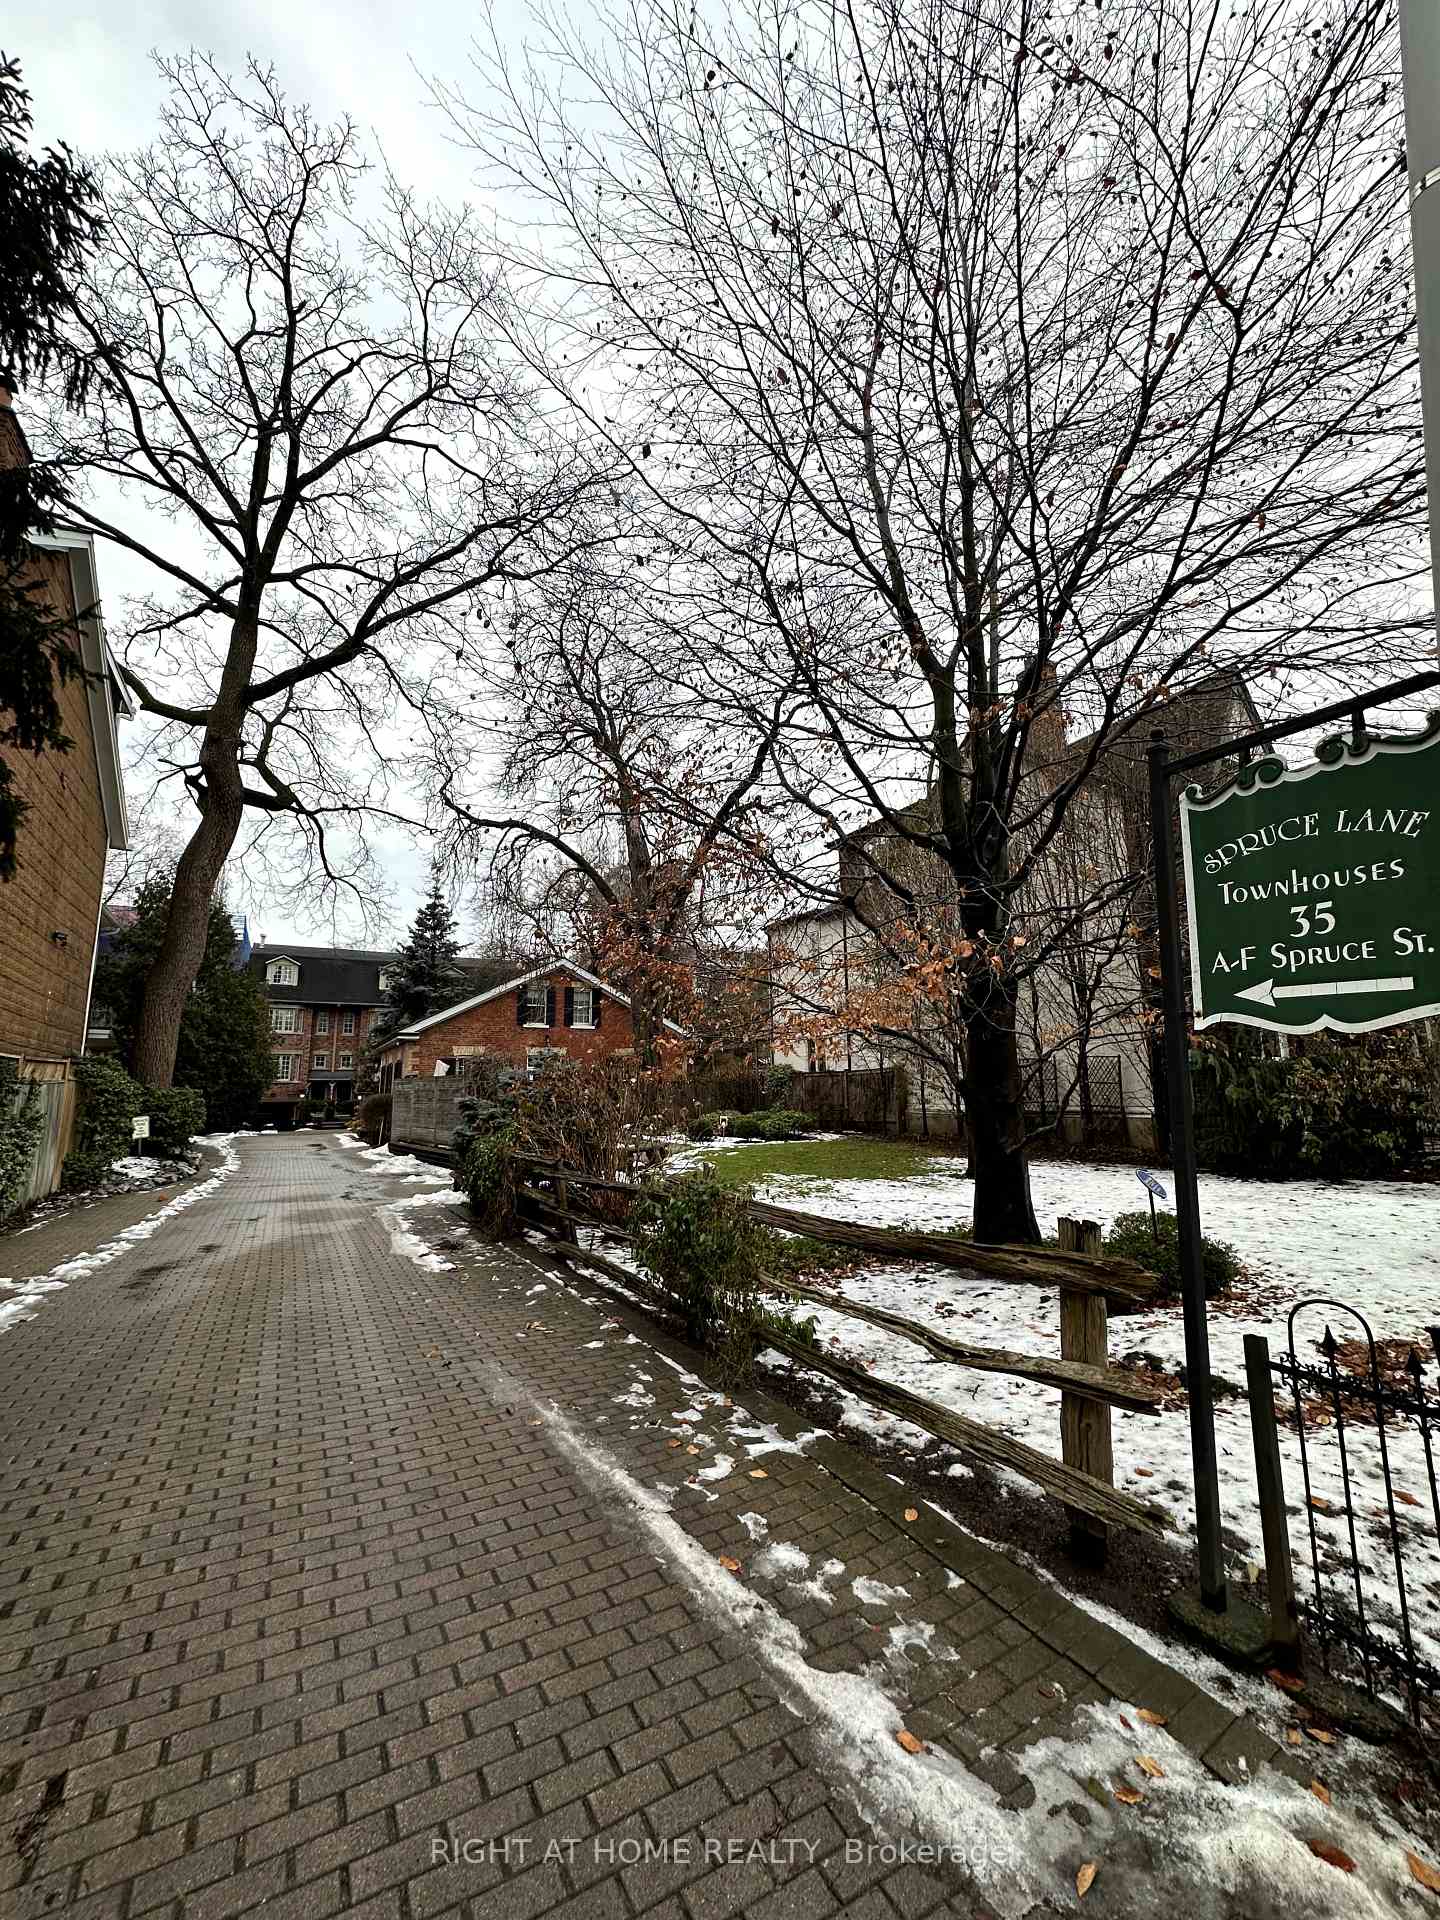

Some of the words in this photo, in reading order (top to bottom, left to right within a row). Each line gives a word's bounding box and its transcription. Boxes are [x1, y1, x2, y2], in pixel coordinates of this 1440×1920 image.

[1203, 811, 1320, 874] SPRUCE
[1334, 808, 1430, 838] LANE
[1289, 900, 1337, 938] 35
[1211, 945, 1257, 975] A-F
[1270, 940, 1377, 973] SPRUCE
